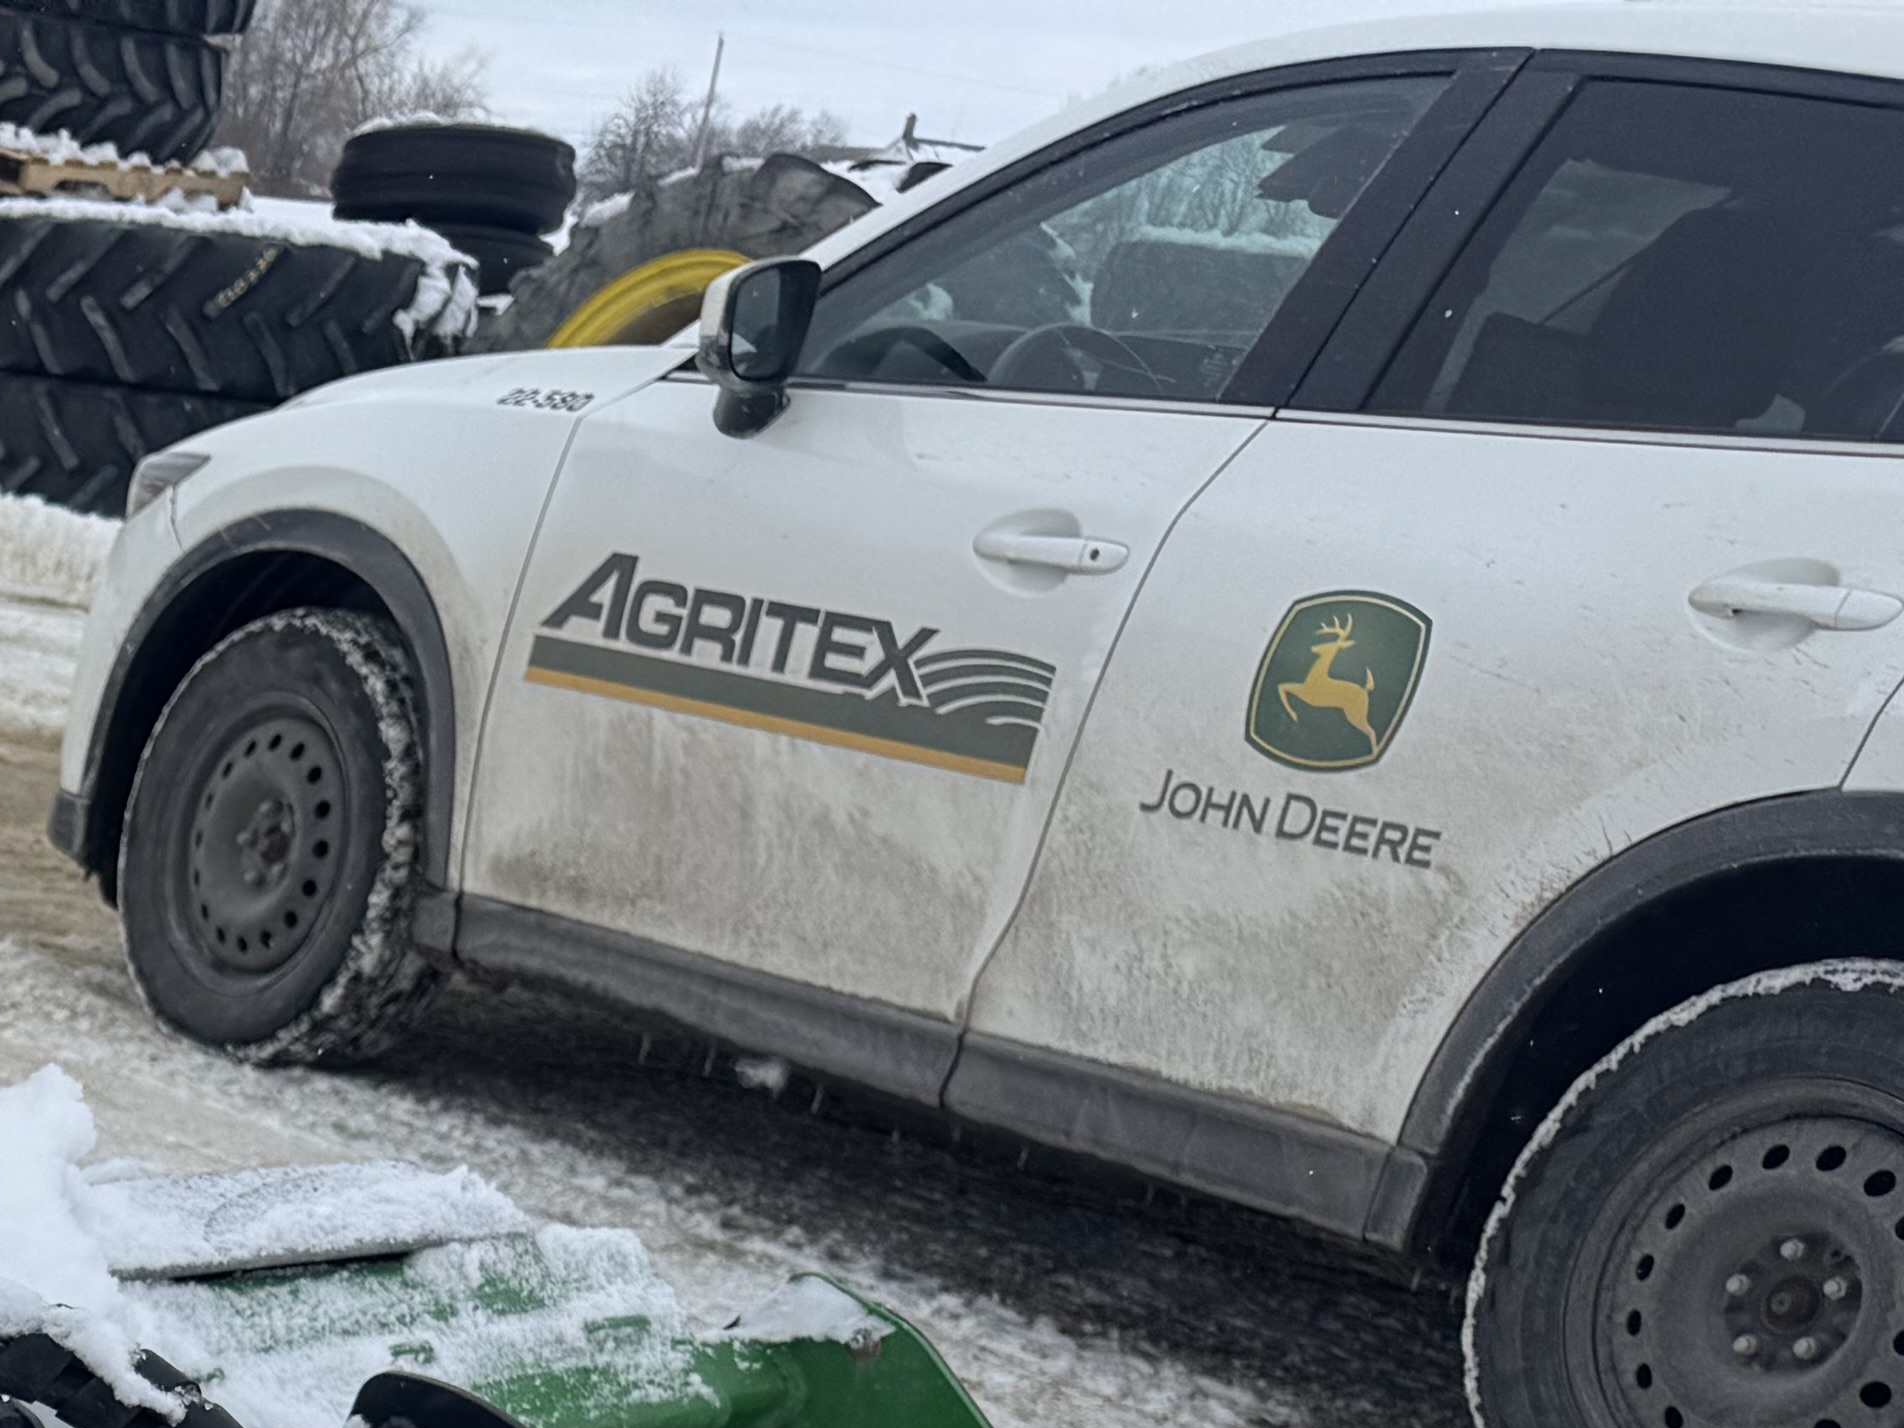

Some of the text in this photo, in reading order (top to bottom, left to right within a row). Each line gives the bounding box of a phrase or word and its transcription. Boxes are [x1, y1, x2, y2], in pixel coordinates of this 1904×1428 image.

[540, 552, 940, 705] AGRITEX
[1139, 769, 1442, 869] JOHN DEERE
